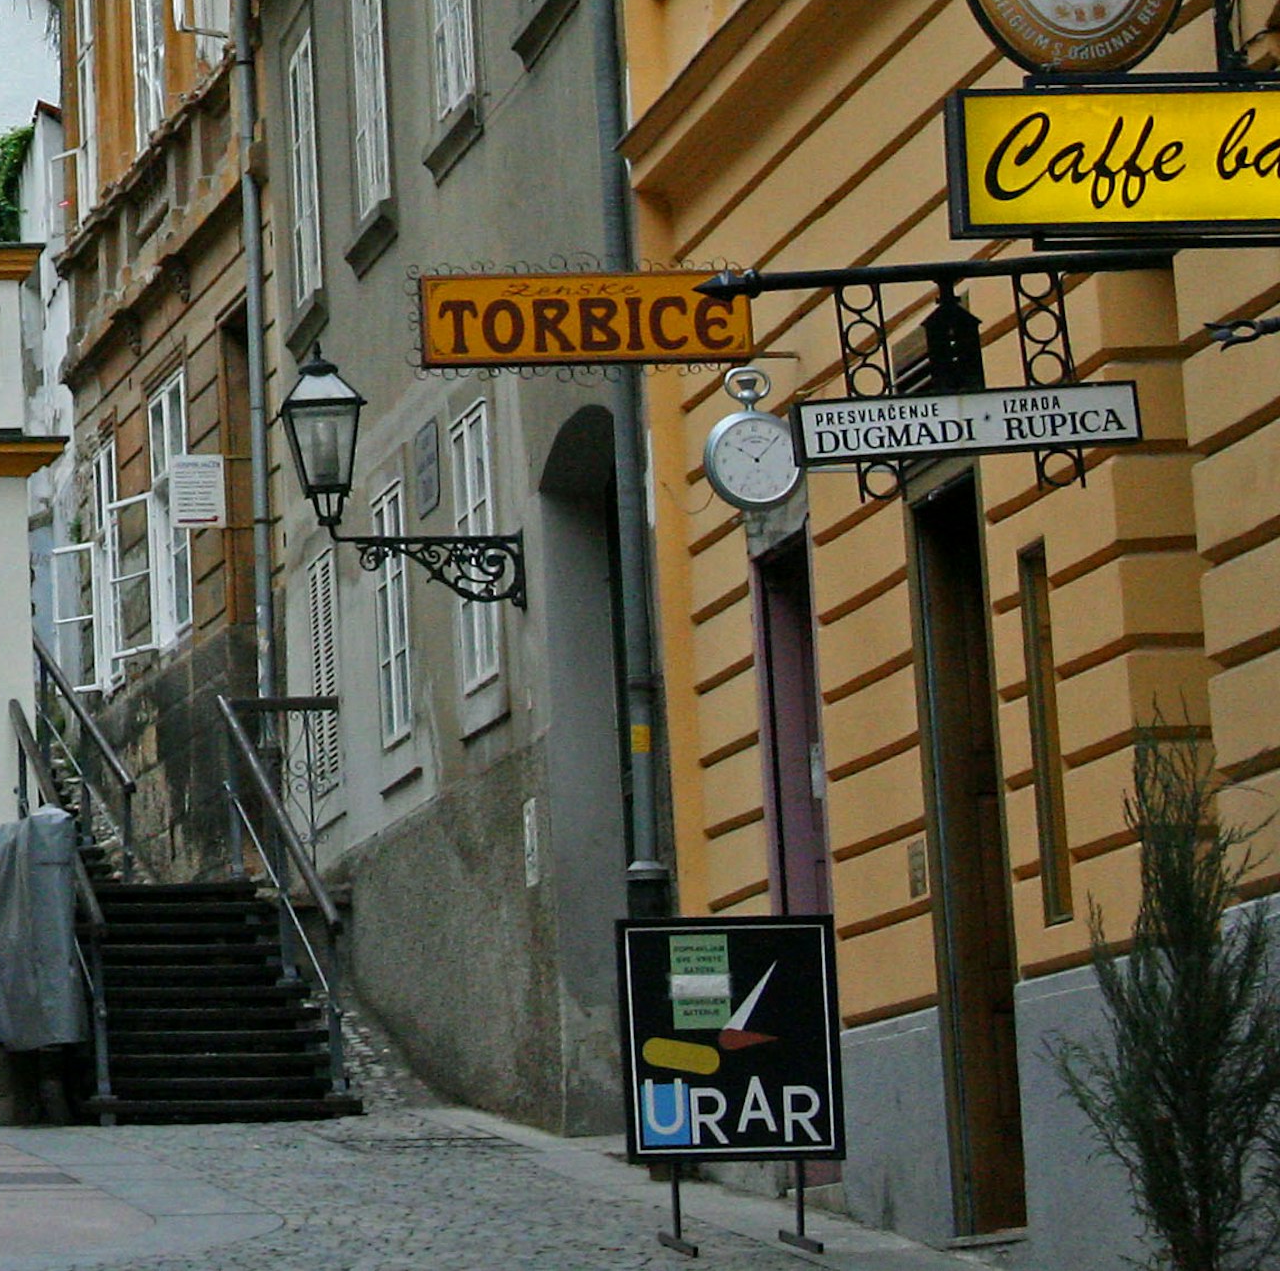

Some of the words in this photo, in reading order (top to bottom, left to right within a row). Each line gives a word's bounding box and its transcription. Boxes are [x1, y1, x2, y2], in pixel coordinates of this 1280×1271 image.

[984, 111, 1187, 209] Caffe
[440, 295, 735, 355] TORBICE
[814, 402, 940, 427] PRESVLAČENJE
[1002, 395, 1061, 414] IZRADA
[815, 417, 978, 454] DUGMADI
[1003, 408, 1127, 441] RUPICA
[643, 1075, 823, 1145] URAR
